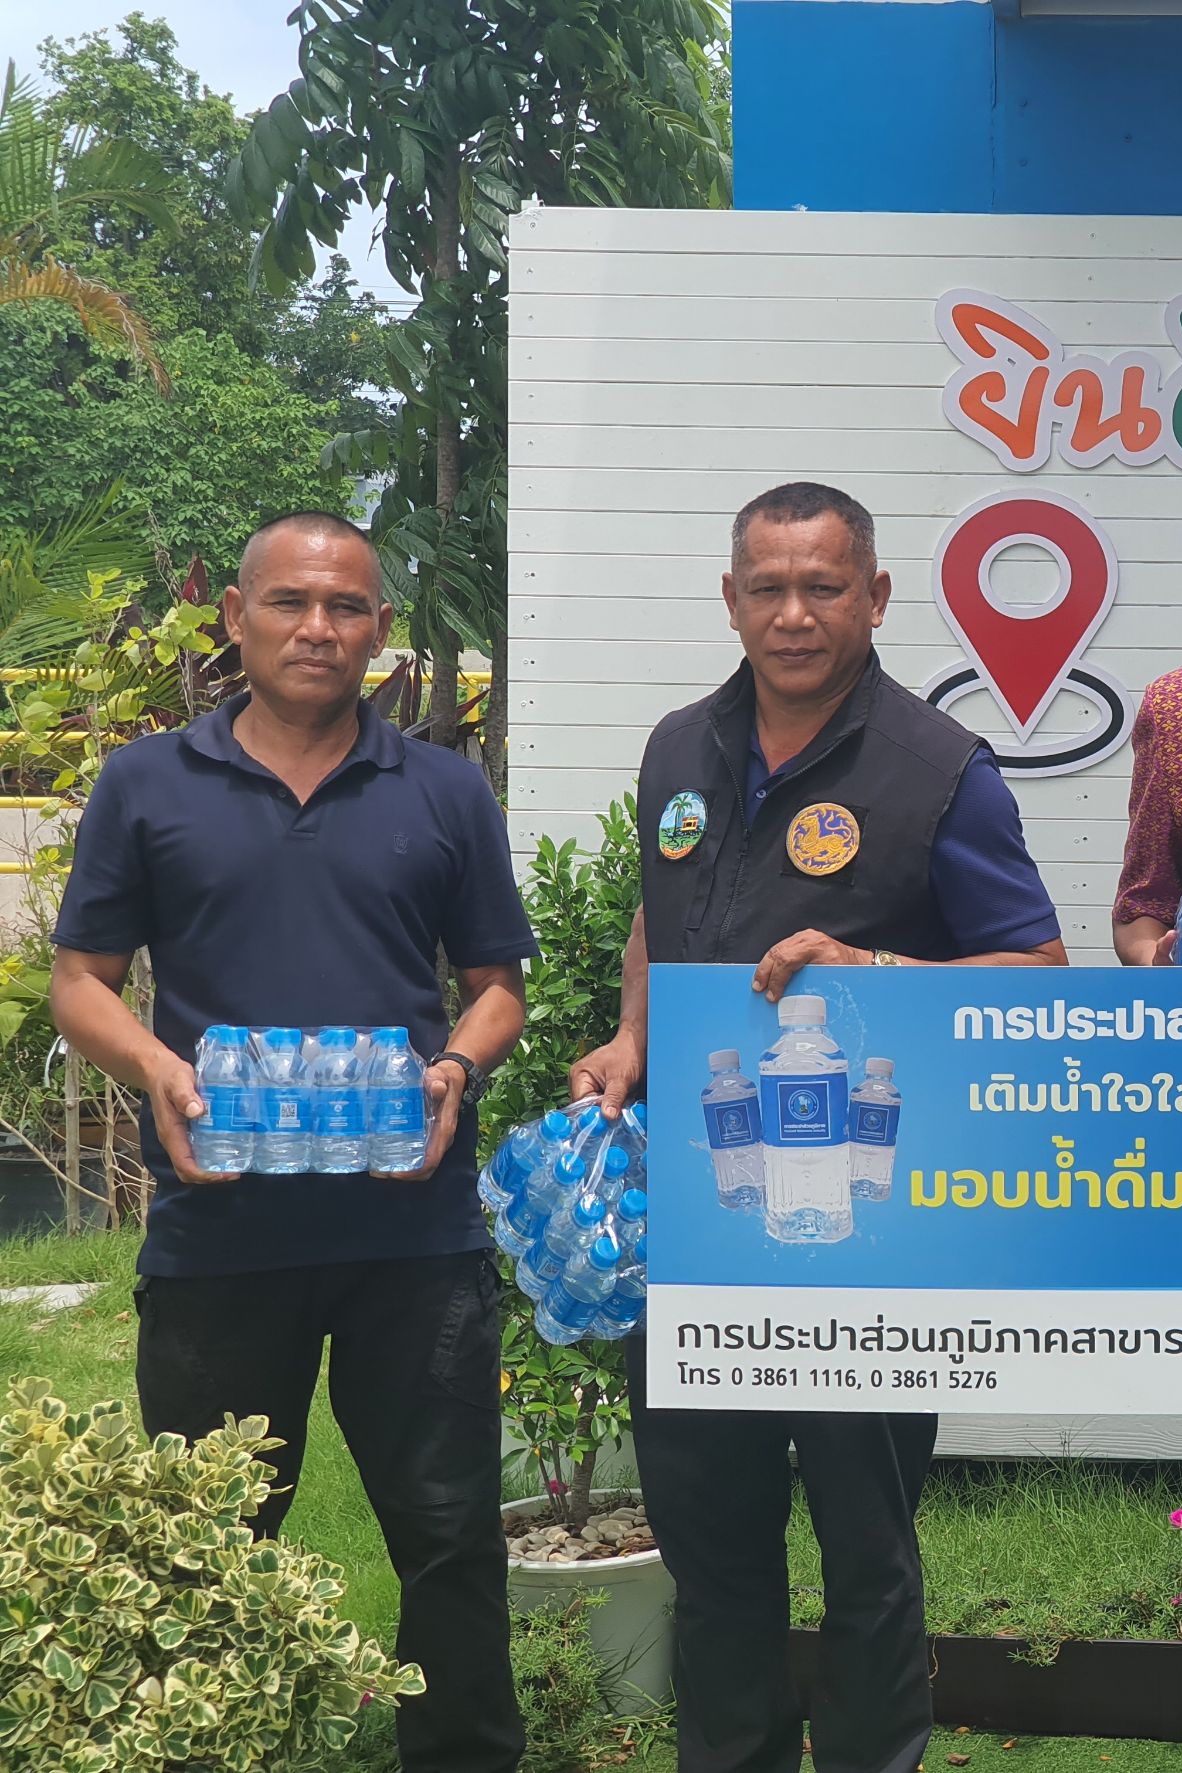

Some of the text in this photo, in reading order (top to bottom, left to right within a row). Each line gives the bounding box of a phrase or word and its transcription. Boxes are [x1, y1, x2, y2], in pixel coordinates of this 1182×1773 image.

[678, 1362, 997, 1390] โทร 0 3861 1116, 0 3861 5276
